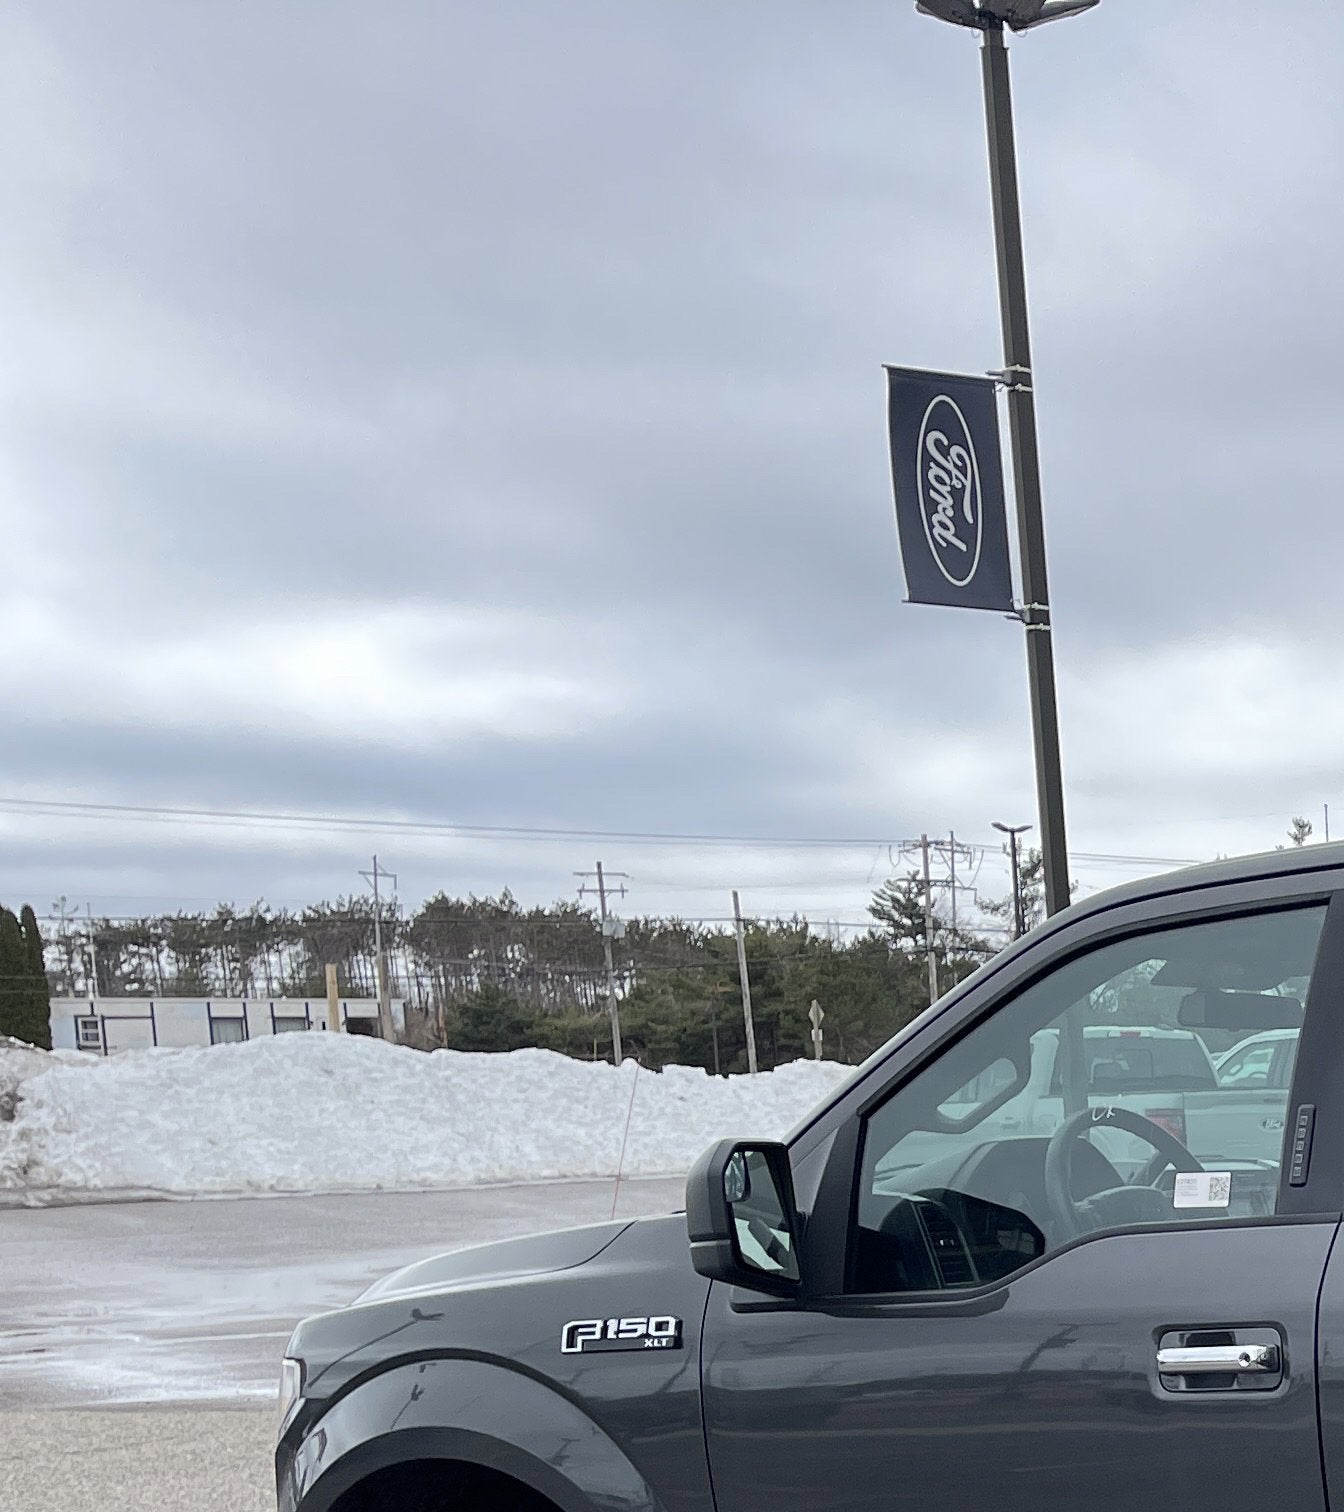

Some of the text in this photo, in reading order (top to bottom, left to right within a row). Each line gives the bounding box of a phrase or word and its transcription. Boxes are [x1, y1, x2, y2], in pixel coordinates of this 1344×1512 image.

[925, 430, 974, 552] Ford
[560, 1315, 677, 1353] F150
[643, 1337, 670, 1348] XLT
